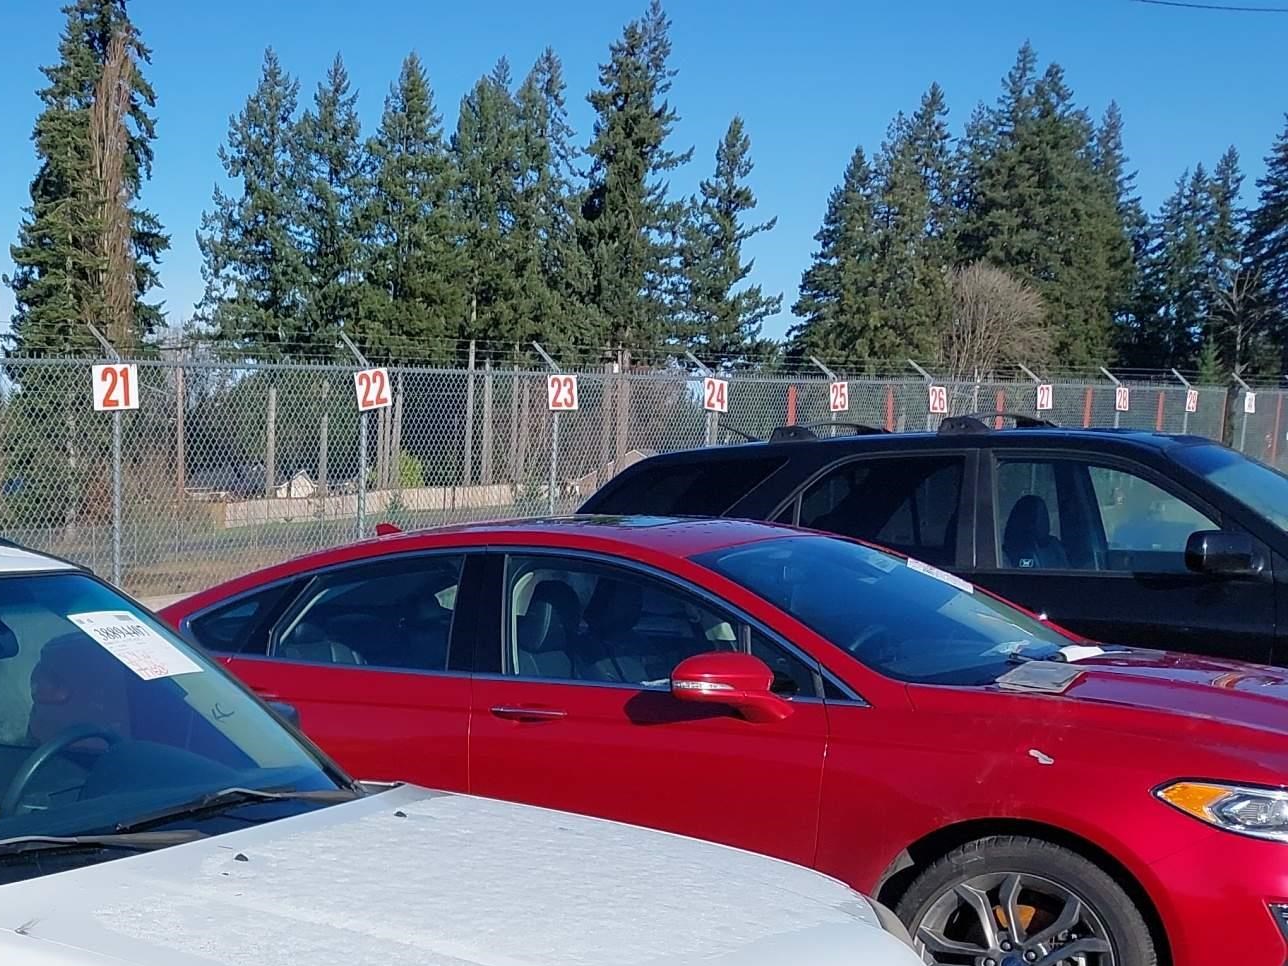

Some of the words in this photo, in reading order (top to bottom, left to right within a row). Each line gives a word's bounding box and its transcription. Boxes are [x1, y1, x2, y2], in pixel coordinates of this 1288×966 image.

[100, 366, 130, 409] 21
[357, 369, 388, 409] 22
[551, 377, 575, 409] 23
[707, 380, 726, 409] 24
[832, 384, 845, 409] 25
[931, 388, 945, 411] 26
[1039, 386, 1051, 408] 27
[1117, 389, 1127, 409] 28
